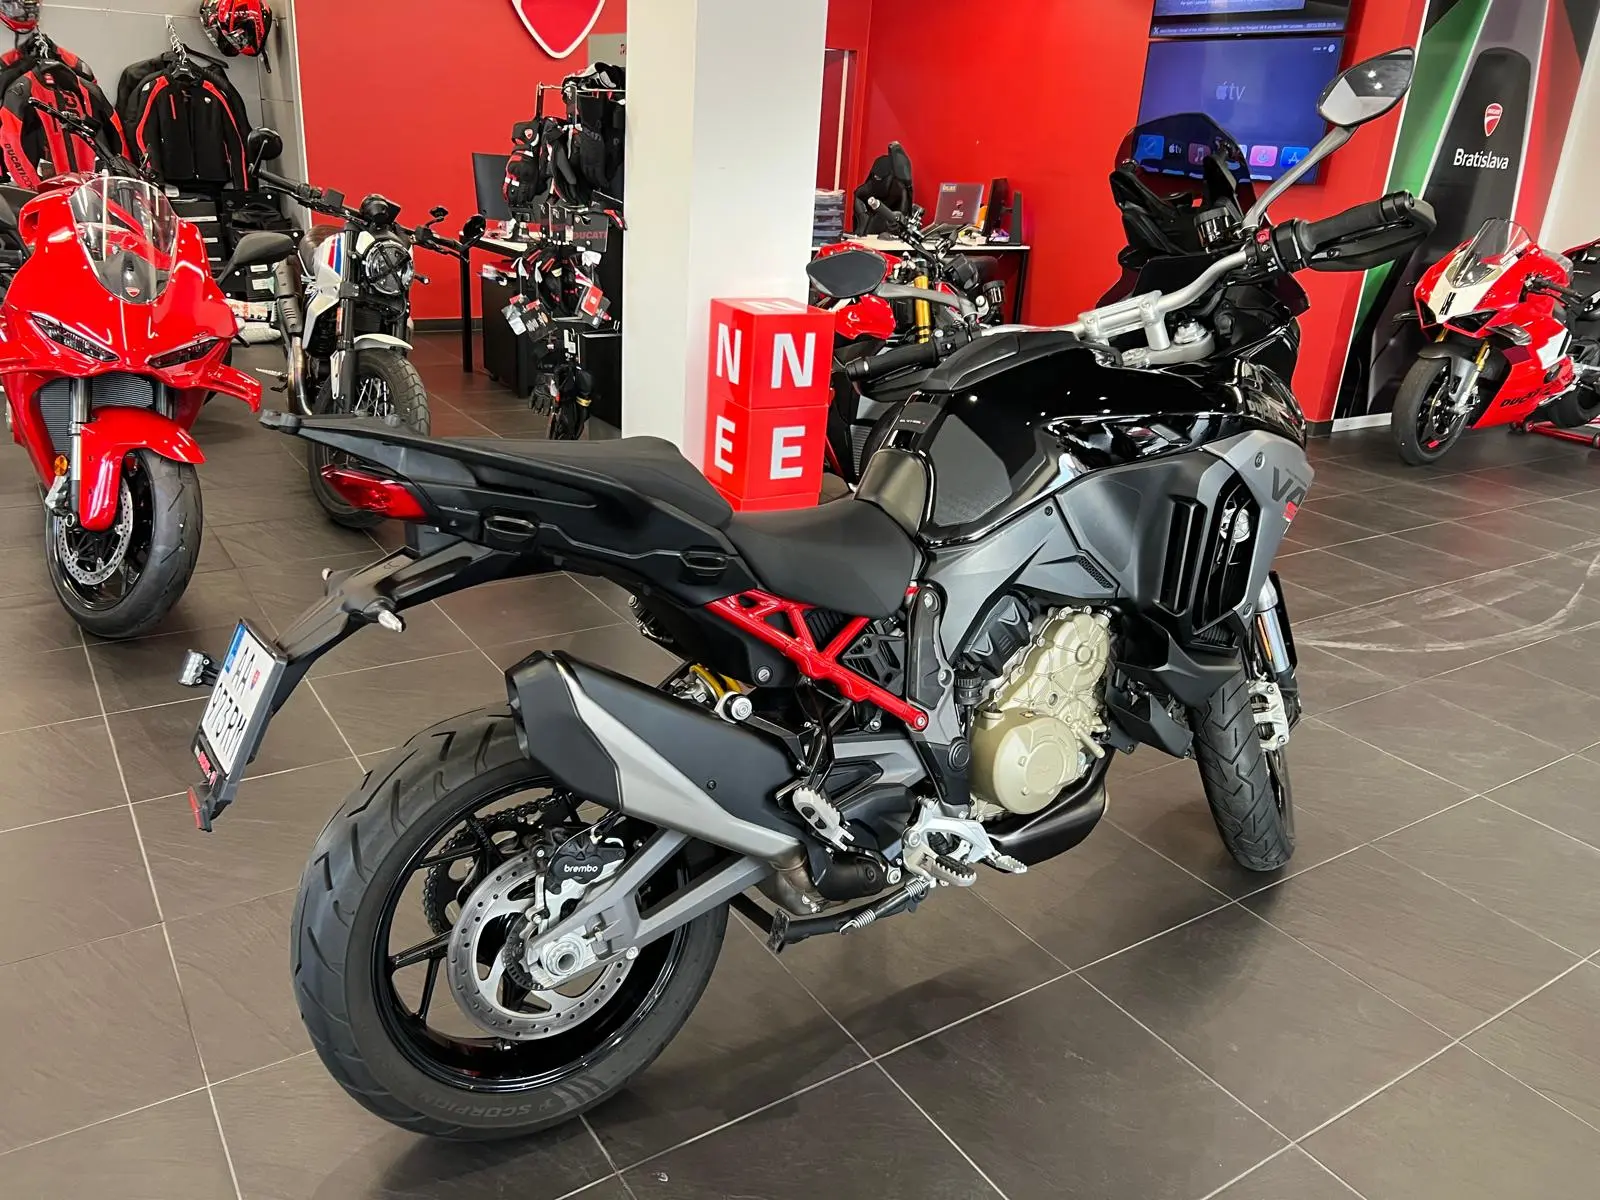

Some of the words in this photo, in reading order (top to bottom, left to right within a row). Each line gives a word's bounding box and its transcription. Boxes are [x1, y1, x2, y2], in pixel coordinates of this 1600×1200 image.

[1229, 83, 1246, 100] tv
[1453, 148, 1509, 169] Bratislava
[770, 332, 816, 389] N
[769, 425, 806, 480] E
[231, 646, 256, 696] AA
[563, 864, 598, 873] brembo
[418, 1092, 532, 1118] SCORPION
